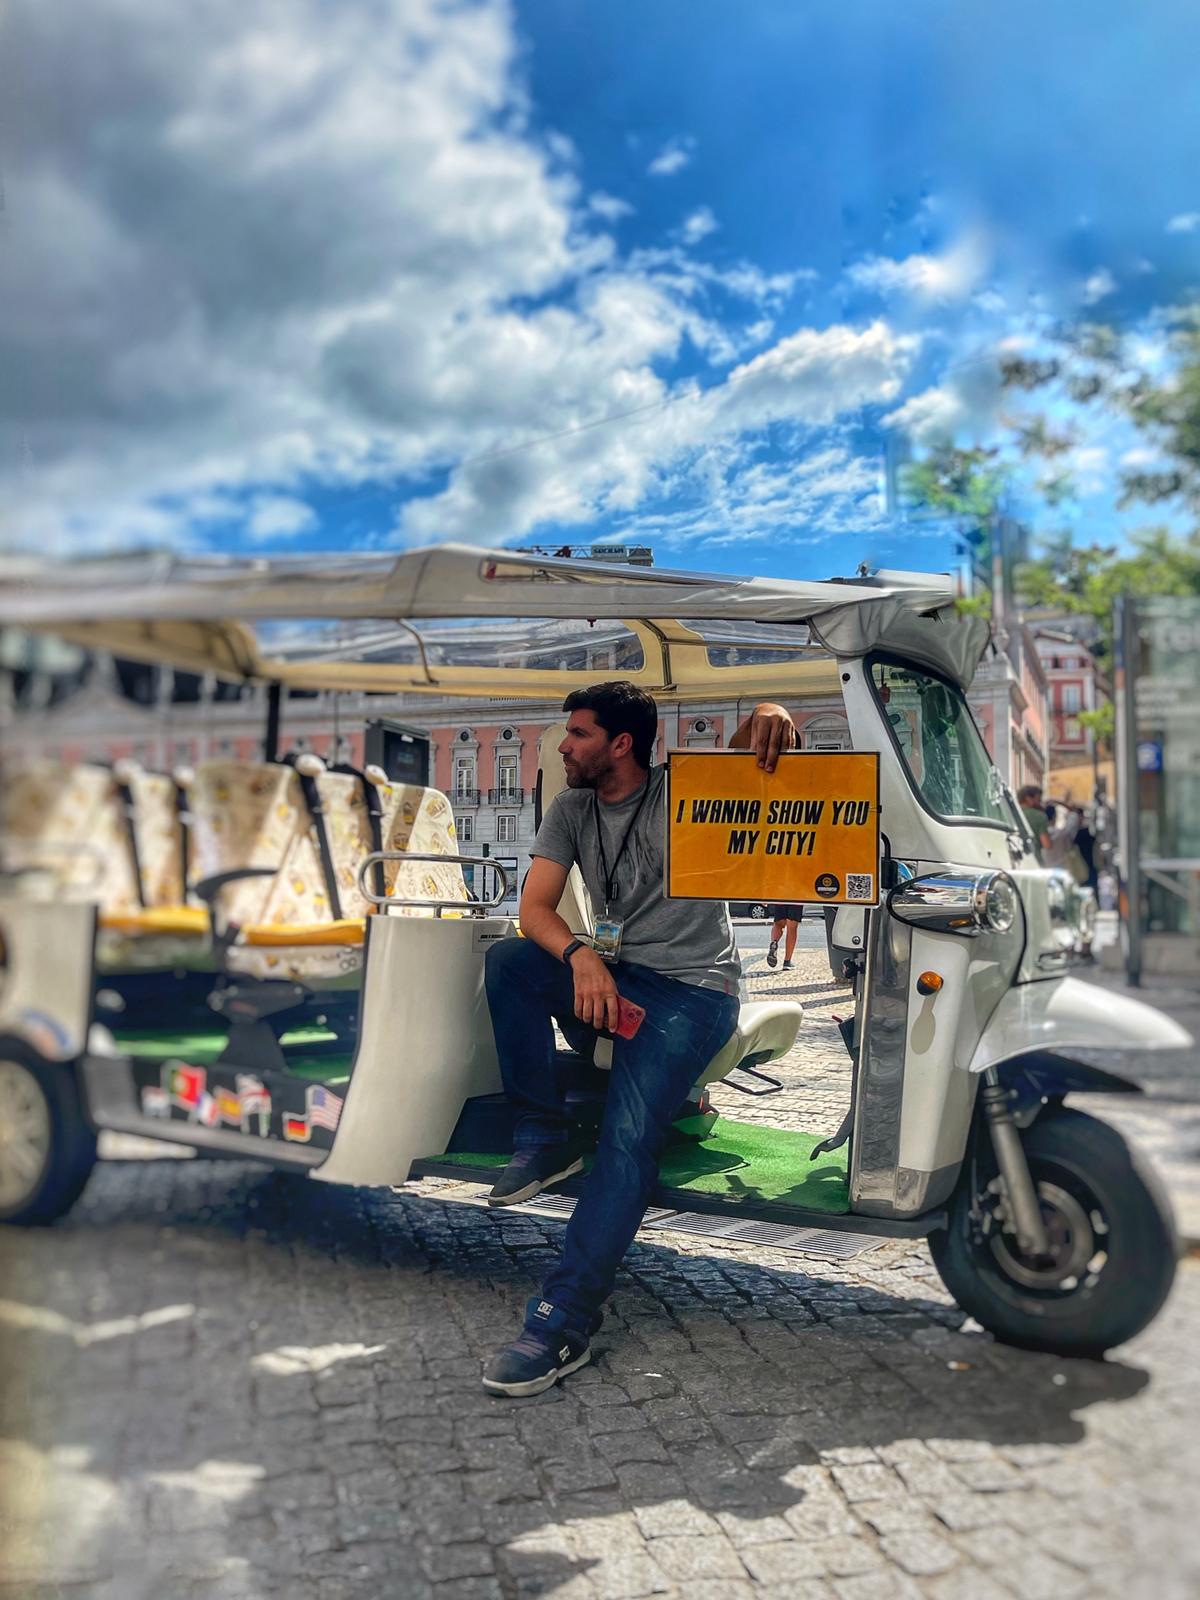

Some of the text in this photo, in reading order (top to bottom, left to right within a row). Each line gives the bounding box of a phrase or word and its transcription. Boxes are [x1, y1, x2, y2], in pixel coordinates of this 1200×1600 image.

[676, 799, 870, 826] I WANNA SHOW YOU
[727, 830, 816, 856] MY CITY!
[537, 1301, 554, 1316] DC
